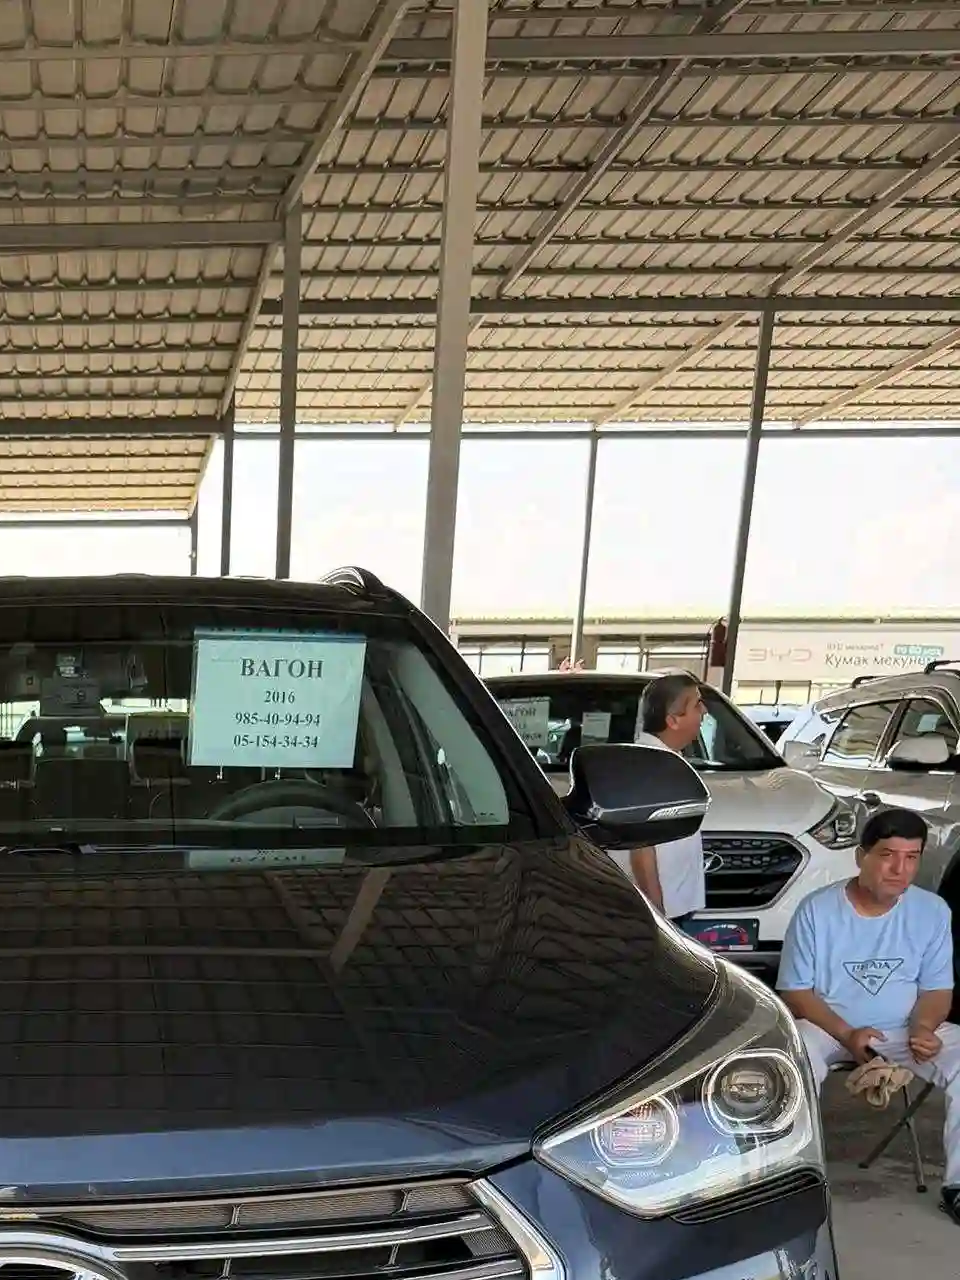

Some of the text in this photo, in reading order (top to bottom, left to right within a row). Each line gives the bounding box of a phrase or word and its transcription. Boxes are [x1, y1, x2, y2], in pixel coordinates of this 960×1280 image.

[240, 657, 325, 679] ВАГОН
[263, 690, 296, 704] 2016
[235, 711, 321, 727] 985-40-94-94
[233, 734, 319, 748] 05-154-34-34
